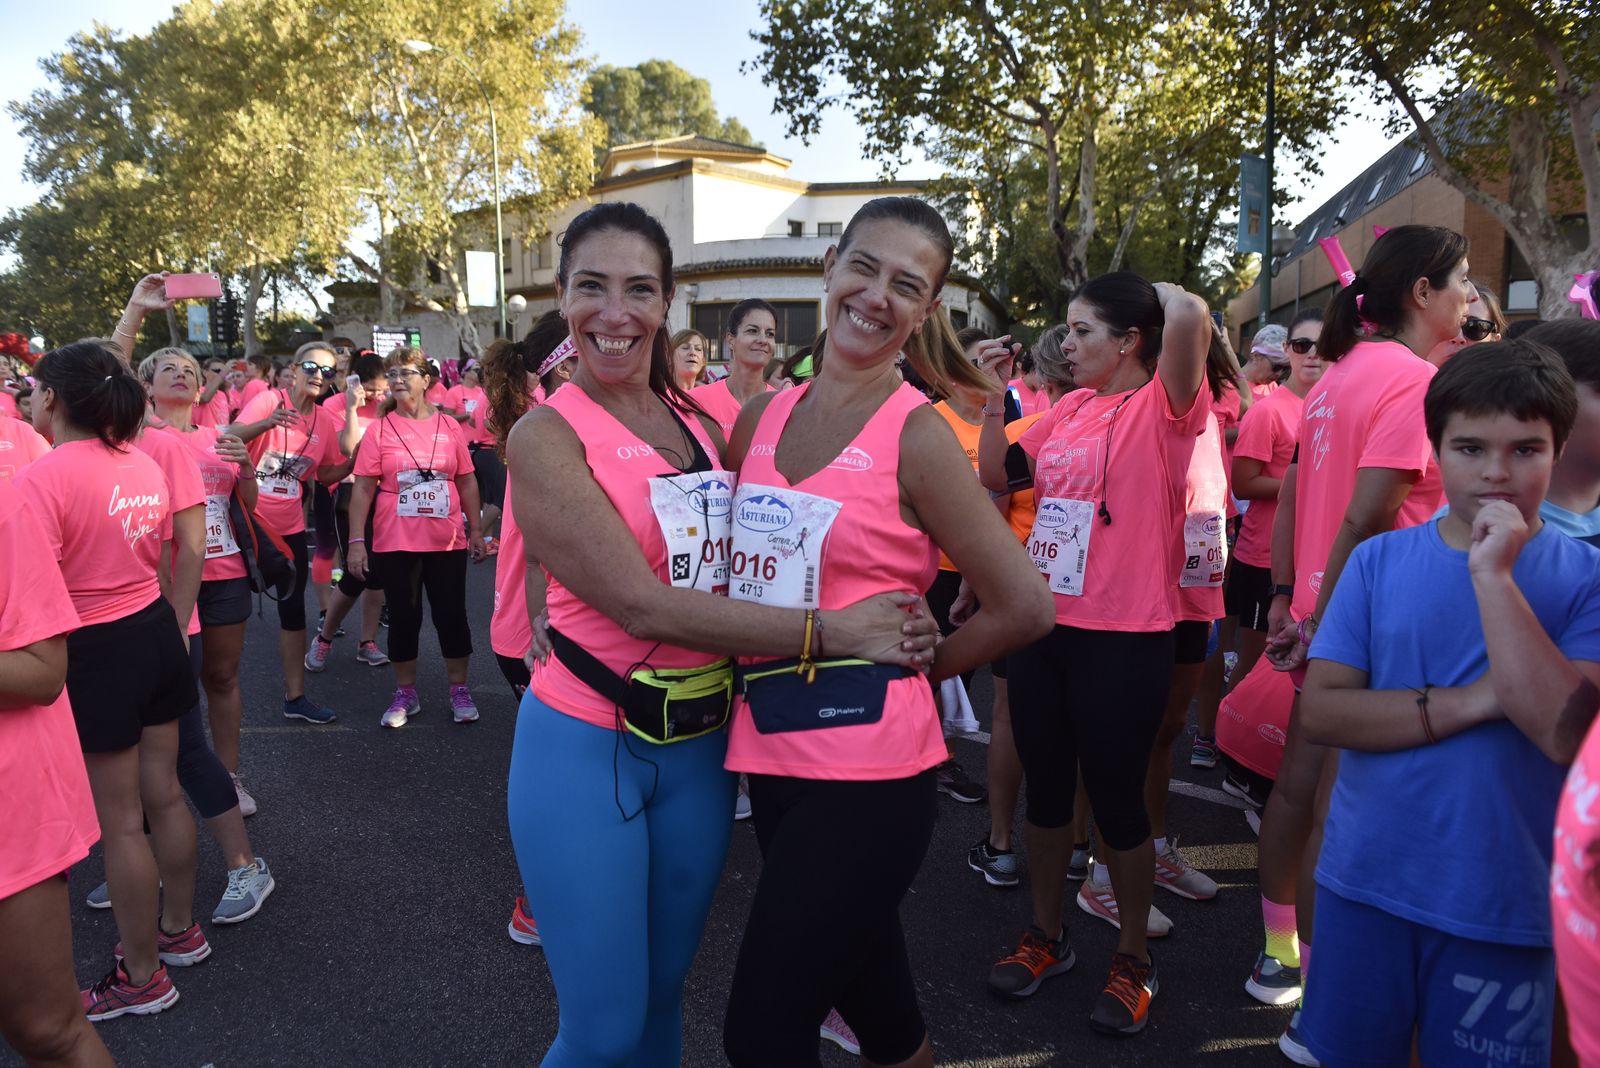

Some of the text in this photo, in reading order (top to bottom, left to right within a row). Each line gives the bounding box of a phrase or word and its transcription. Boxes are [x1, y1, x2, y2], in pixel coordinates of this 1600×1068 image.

[413, 491, 436, 500] 016
[738, 506, 787, 526] ASTURIANA
[205, 525, 222, 536] 16
[1032, 540, 1059, 559] 016
[731, 550, 778, 581] 016
[739, 582, 764, 598] 4713
[836, 706, 865, 715] Kalenji
[1453, 973, 1548, 1041] 72
